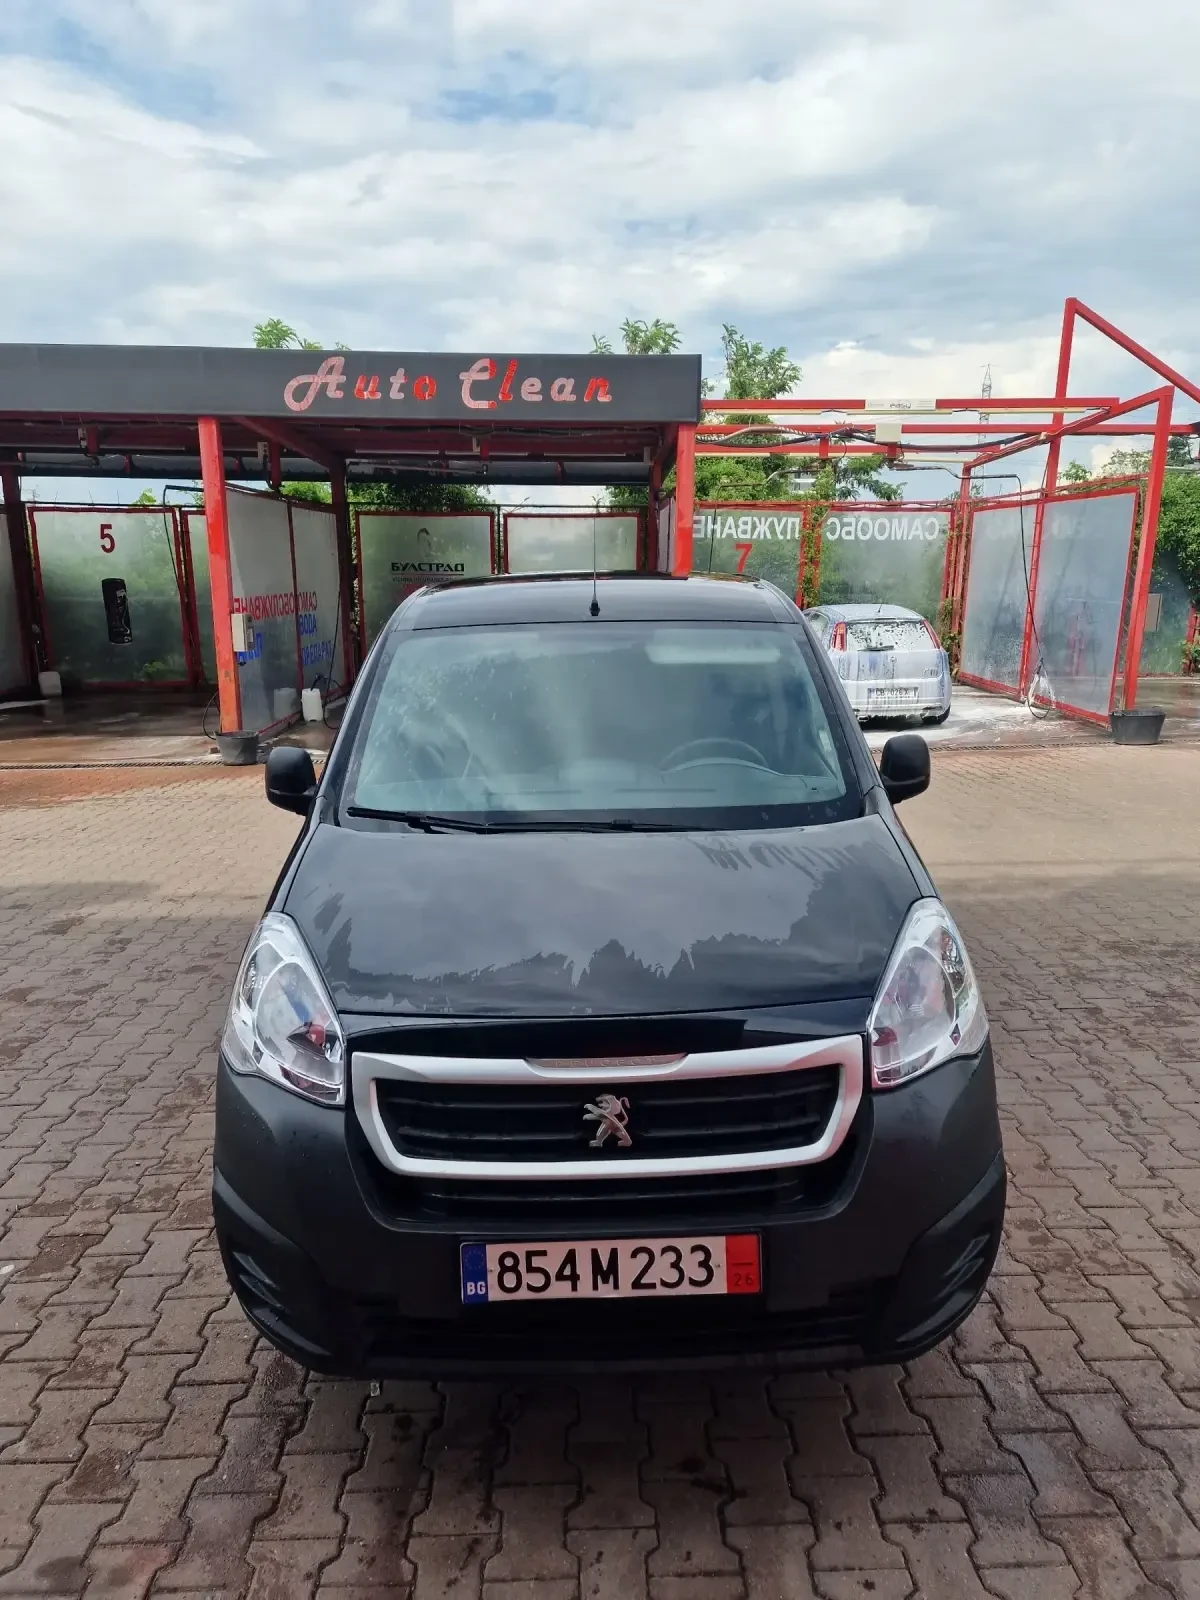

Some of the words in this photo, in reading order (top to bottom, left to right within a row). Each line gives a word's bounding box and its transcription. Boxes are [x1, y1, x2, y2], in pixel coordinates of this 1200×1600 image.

[284, 356, 437, 411] Auto
[459, 358, 612, 409] Clean
[100, 523, 116, 553] 5
[391, 562, 465, 572] БУЛСТРАД
[734, 543, 753, 573] 7
[556, 1058, 655, 1067] PEUGEOT
[467, 1281, 486, 1295] BG
[497, 1248, 580, 1293] 854
[590, 1247, 619, 1291] M
[630, 1244, 714, 1290] 233
[733, 1272, 754, 1287] 26
